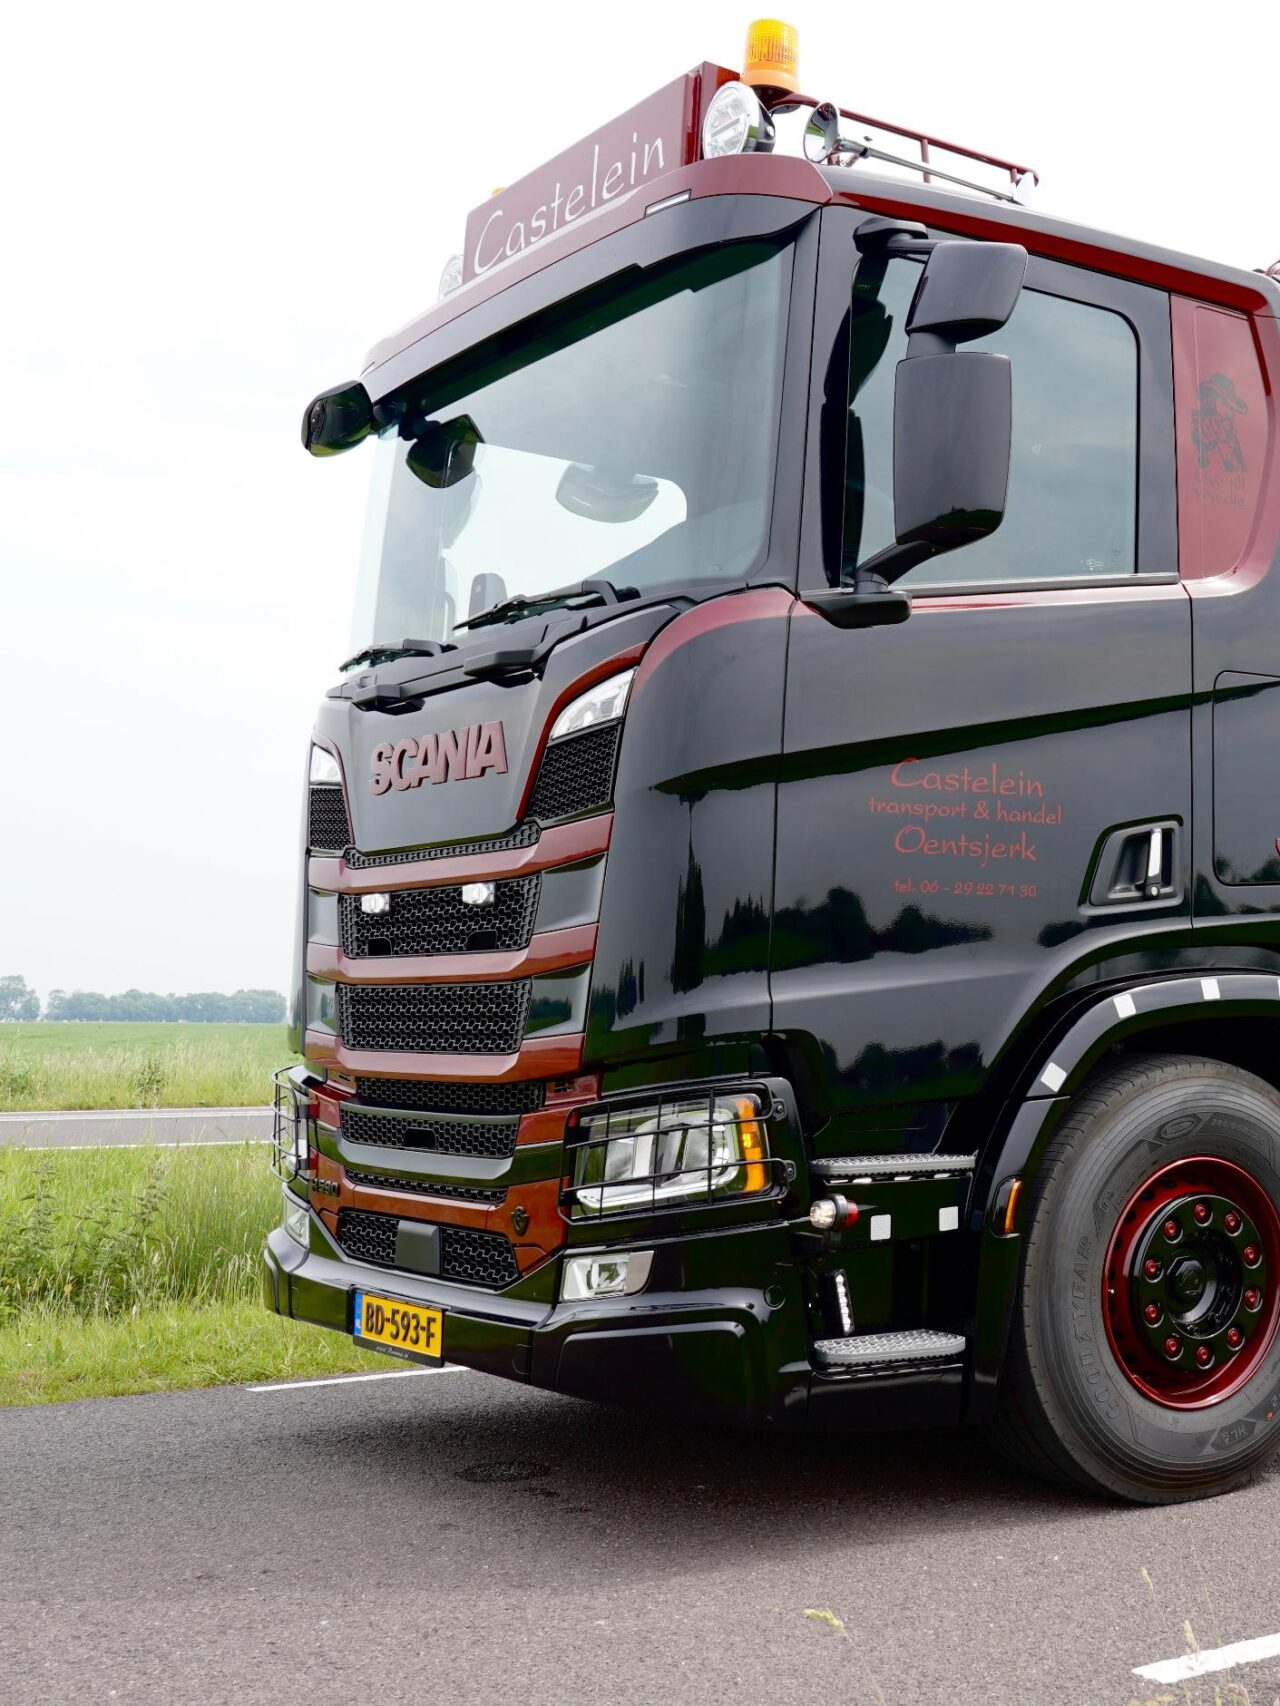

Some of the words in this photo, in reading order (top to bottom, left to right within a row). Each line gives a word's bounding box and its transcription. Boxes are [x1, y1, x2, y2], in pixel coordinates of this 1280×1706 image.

[474, 132, 665, 274] Castelein
[368, 720, 508, 795] SCANIA
[890, 757, 1043, 797] Castelein
[868, 796, 967, 822] transport
[973, 800, 991, 820] &
[997, 801, 1063, 825] handel
[894, 824, 1038, 867] Oentsjerk
[893, 878, 916, 893] tel.
[920, 880, 939, 894] 06
[365, 1302, 437, 1348] BD-593-F
